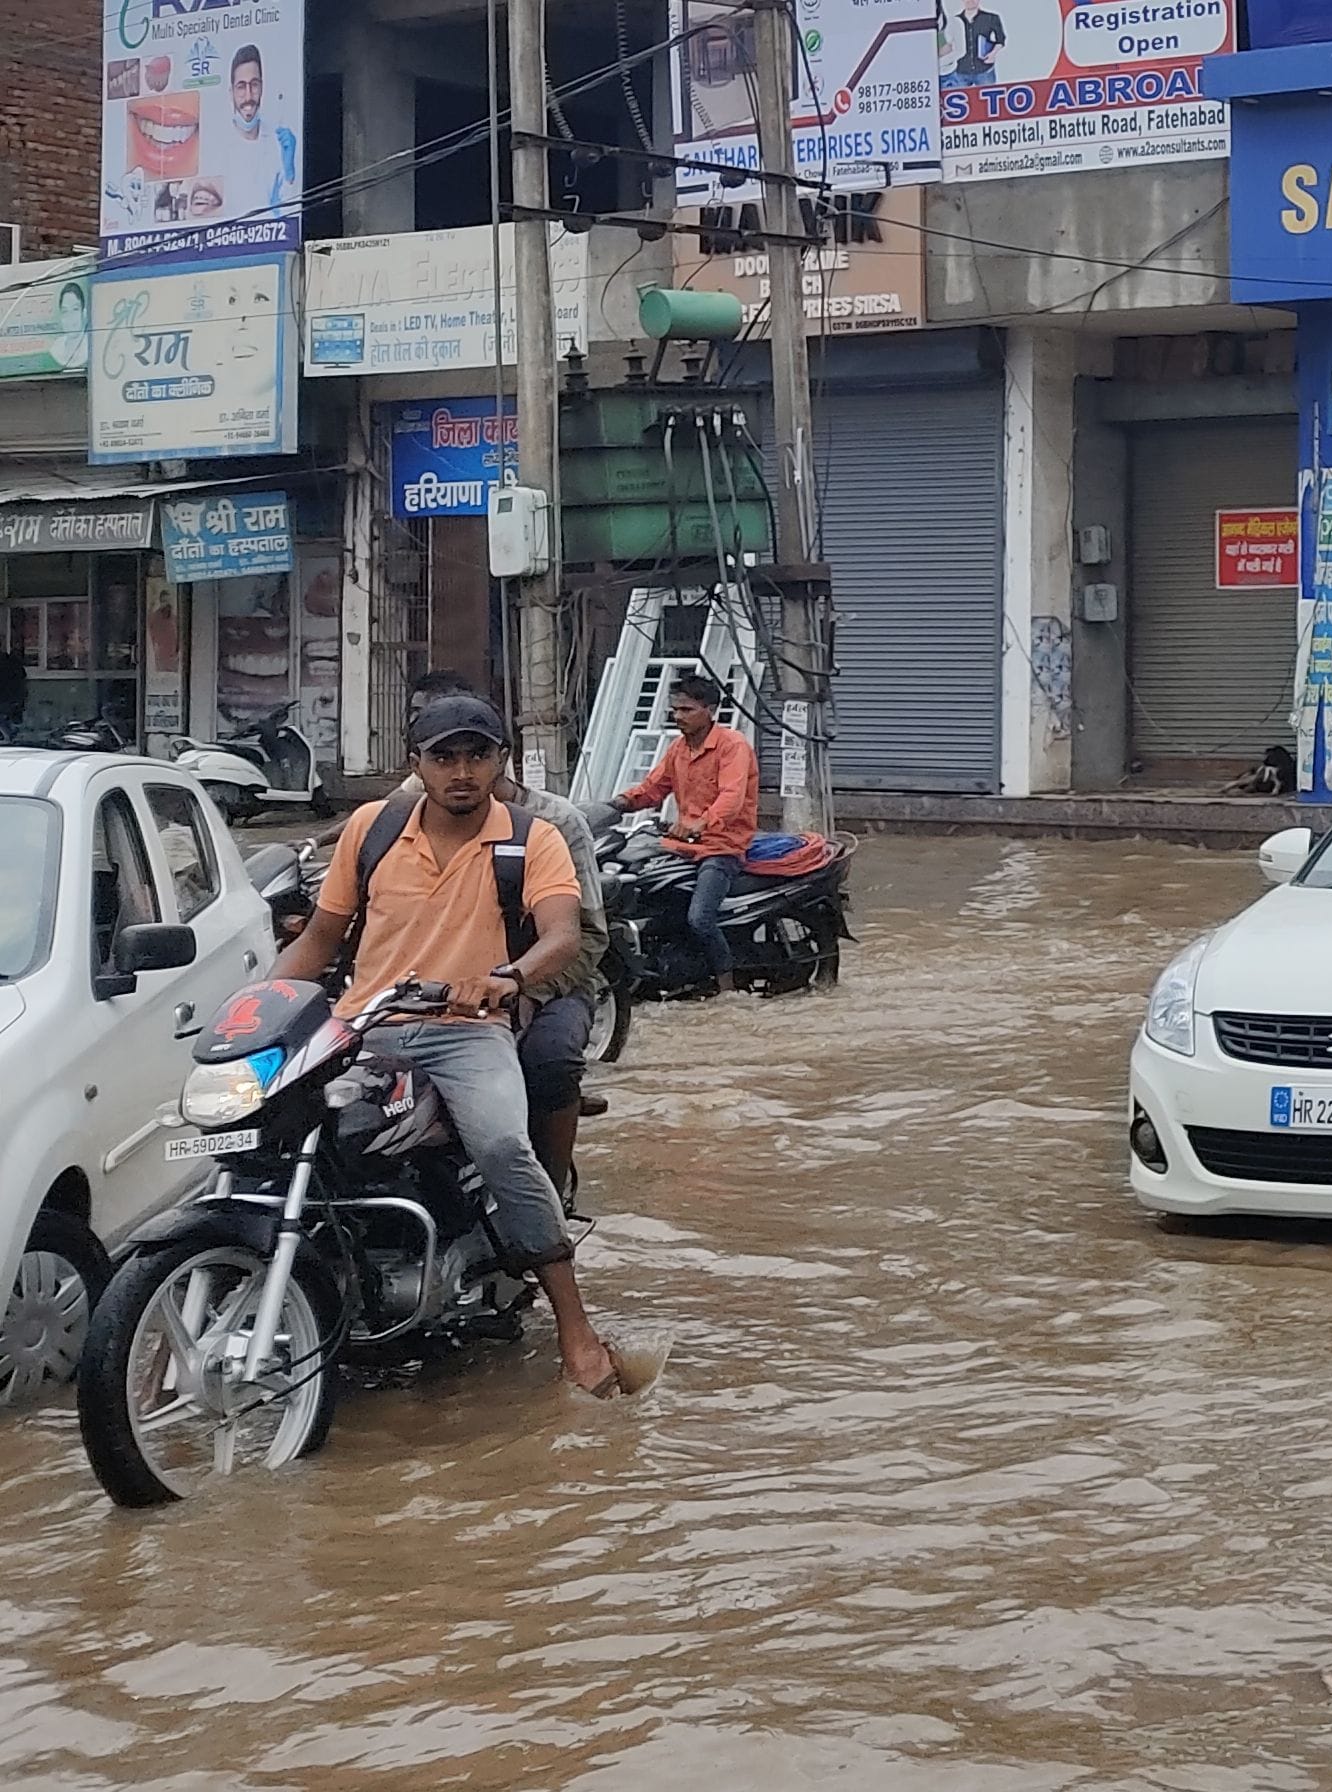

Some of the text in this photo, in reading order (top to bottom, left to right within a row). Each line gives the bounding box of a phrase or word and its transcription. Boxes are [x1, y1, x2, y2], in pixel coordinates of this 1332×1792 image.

[152, 22, 174, 40] Multi
[177, 16, 220, 38] Speciality
[223, 11, 253, 29] Dental
[255, 6, 280, 24] Clinic
[1075, 0, 1221, 31] Registration
[1118, 34, 1179, 56] Open
[191, 61, 210, 77] SR
[858, 80, 931, 98] 98177-08862
[982, 67, 1203, 117] TO ABROA
[858, 97, 931, 114] 98177-08852
[881, 127, 931, 155] SIRSA
[983, 121, 1044, 152] Hospital,
[1050, 117, 1096, 139] Bhattu
[1102, 112, 1142, 137] Road,
[1149, 106, 1225, 131] Fatehabad
[1117, 137, 1226, 158] www.a2aconsultants.com
[854, 293, 902, 316] SIRSA
[370, 322, 389, 333] Deals
[404, 315, 421, 331] LED
[424, 314, 438, 332] TV,
[440, 313, 467, 330] Home
[469, 310, 508, 328] Theatr,
[134, 328, 193, 371] राम
[151, 381, 166, 399] का
[431, 407, 482, 449] जिला
[403, 472, 484, 513] हरियाणा
[205, 498, 287, 535] श्री राम
[208, 534, 289, 557] का हस्पताल
[383, 1096, 414, 1118] Hero
[1293, 1099, 1313, 1124] HR
